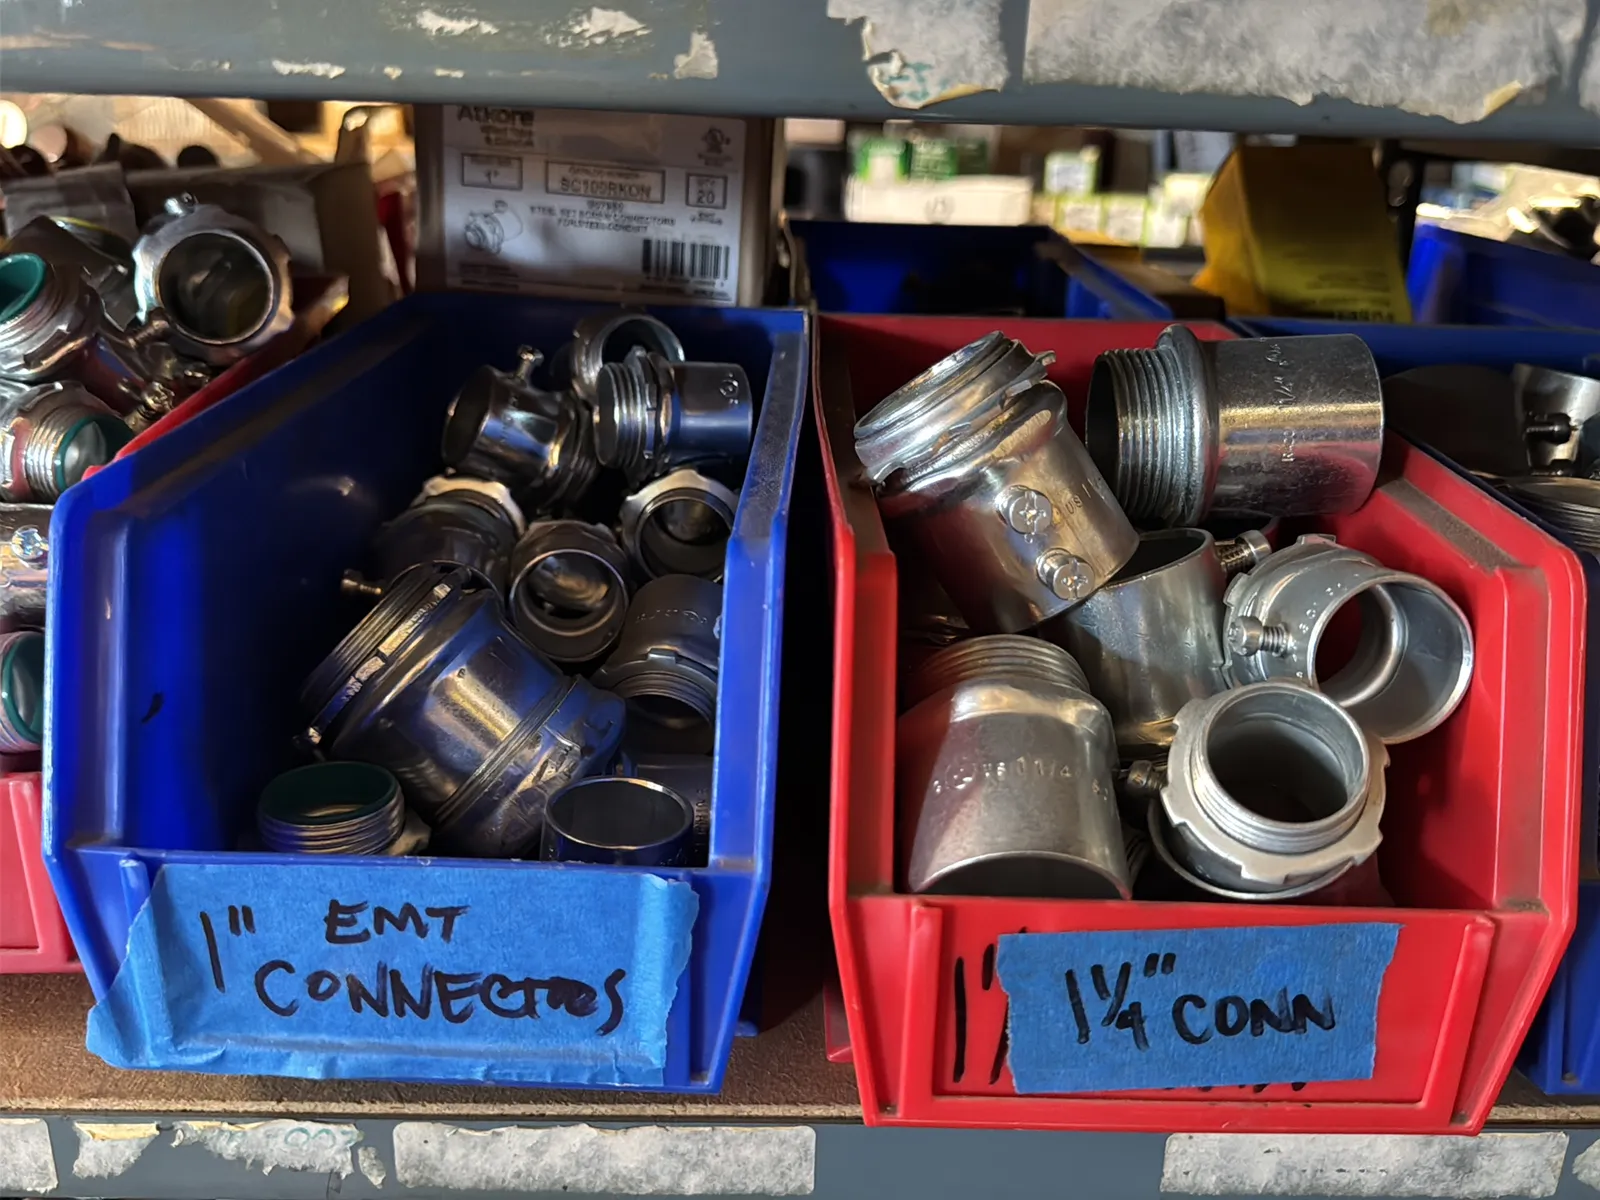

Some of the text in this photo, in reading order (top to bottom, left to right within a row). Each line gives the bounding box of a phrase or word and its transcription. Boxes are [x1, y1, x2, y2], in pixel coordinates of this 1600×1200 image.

[697, 188, 716, 205] 20
[324, 899, 471, 945] EMT
[1172, 985, 1337, 1046] CONN
